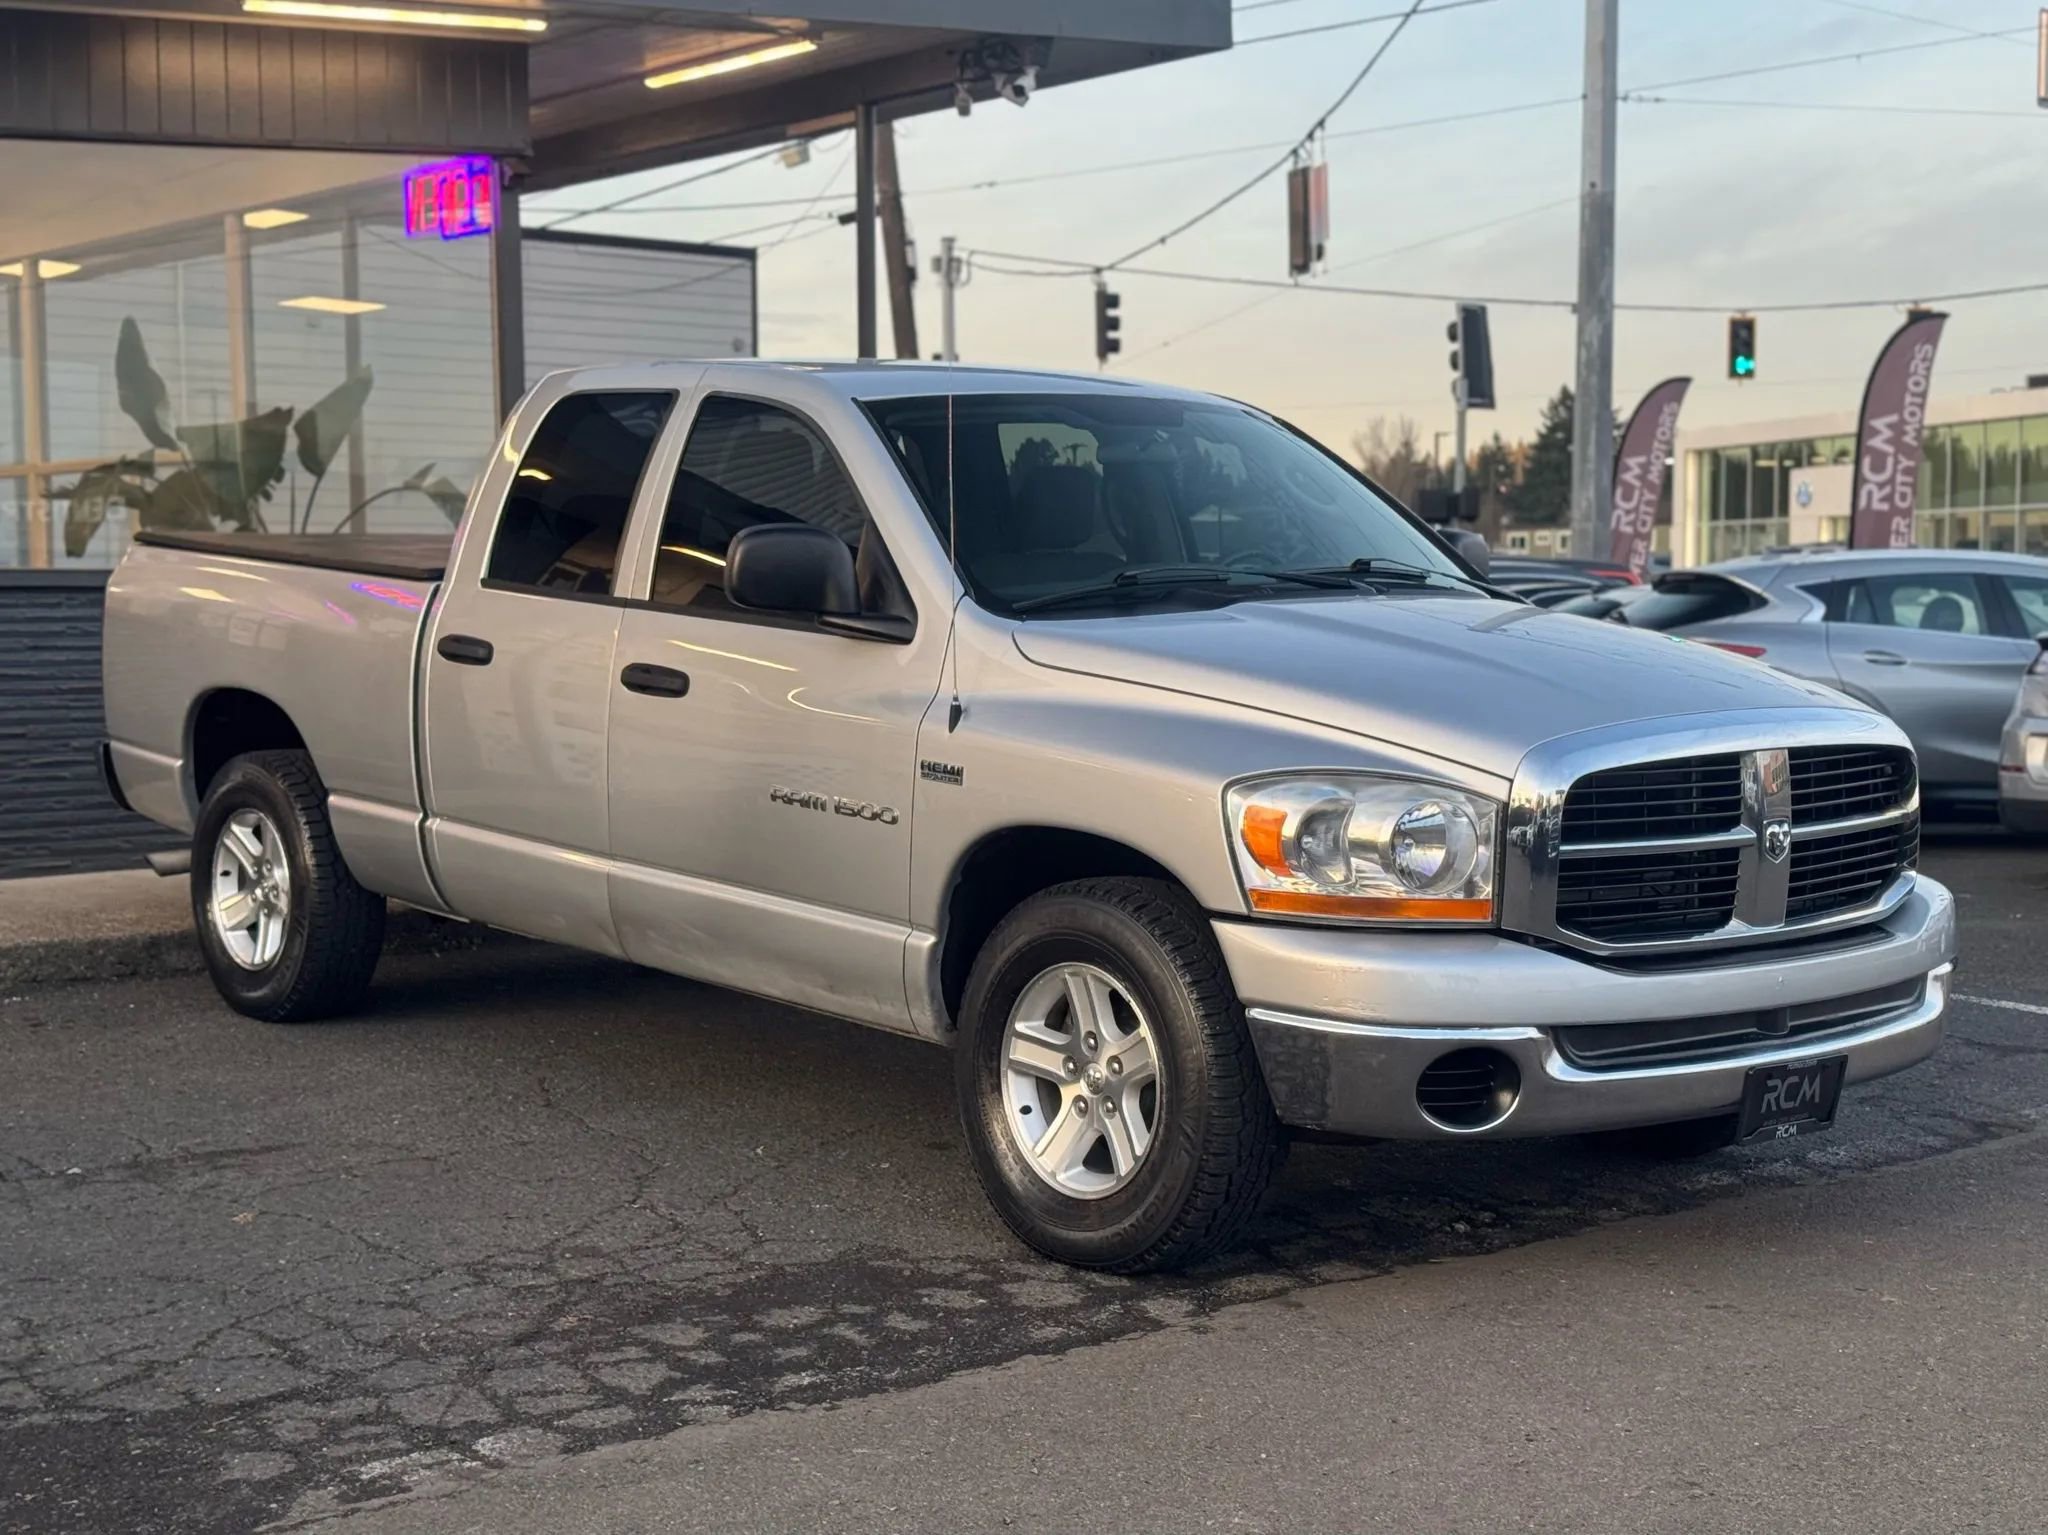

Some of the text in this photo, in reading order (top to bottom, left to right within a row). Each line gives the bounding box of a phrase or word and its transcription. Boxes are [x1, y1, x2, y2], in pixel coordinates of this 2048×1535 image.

[1901, 342, 1934, 447] MOTORS
[1636, 488, 1657, 533] CITY
[1647, 400, 1680, 485] MOTORS
[1859, 412, 1900, 511] RCM
[1895, 454, 1916, 509] CITY
[1610, 454, 1648, 534] RCM
[920, 759, 963, 778] HEMI
[770, 783, 900, 825] RAM 1500
[1760, 1072, 1820, 1114] RCM
[1775, 1124, 1798, 1139] RCM
